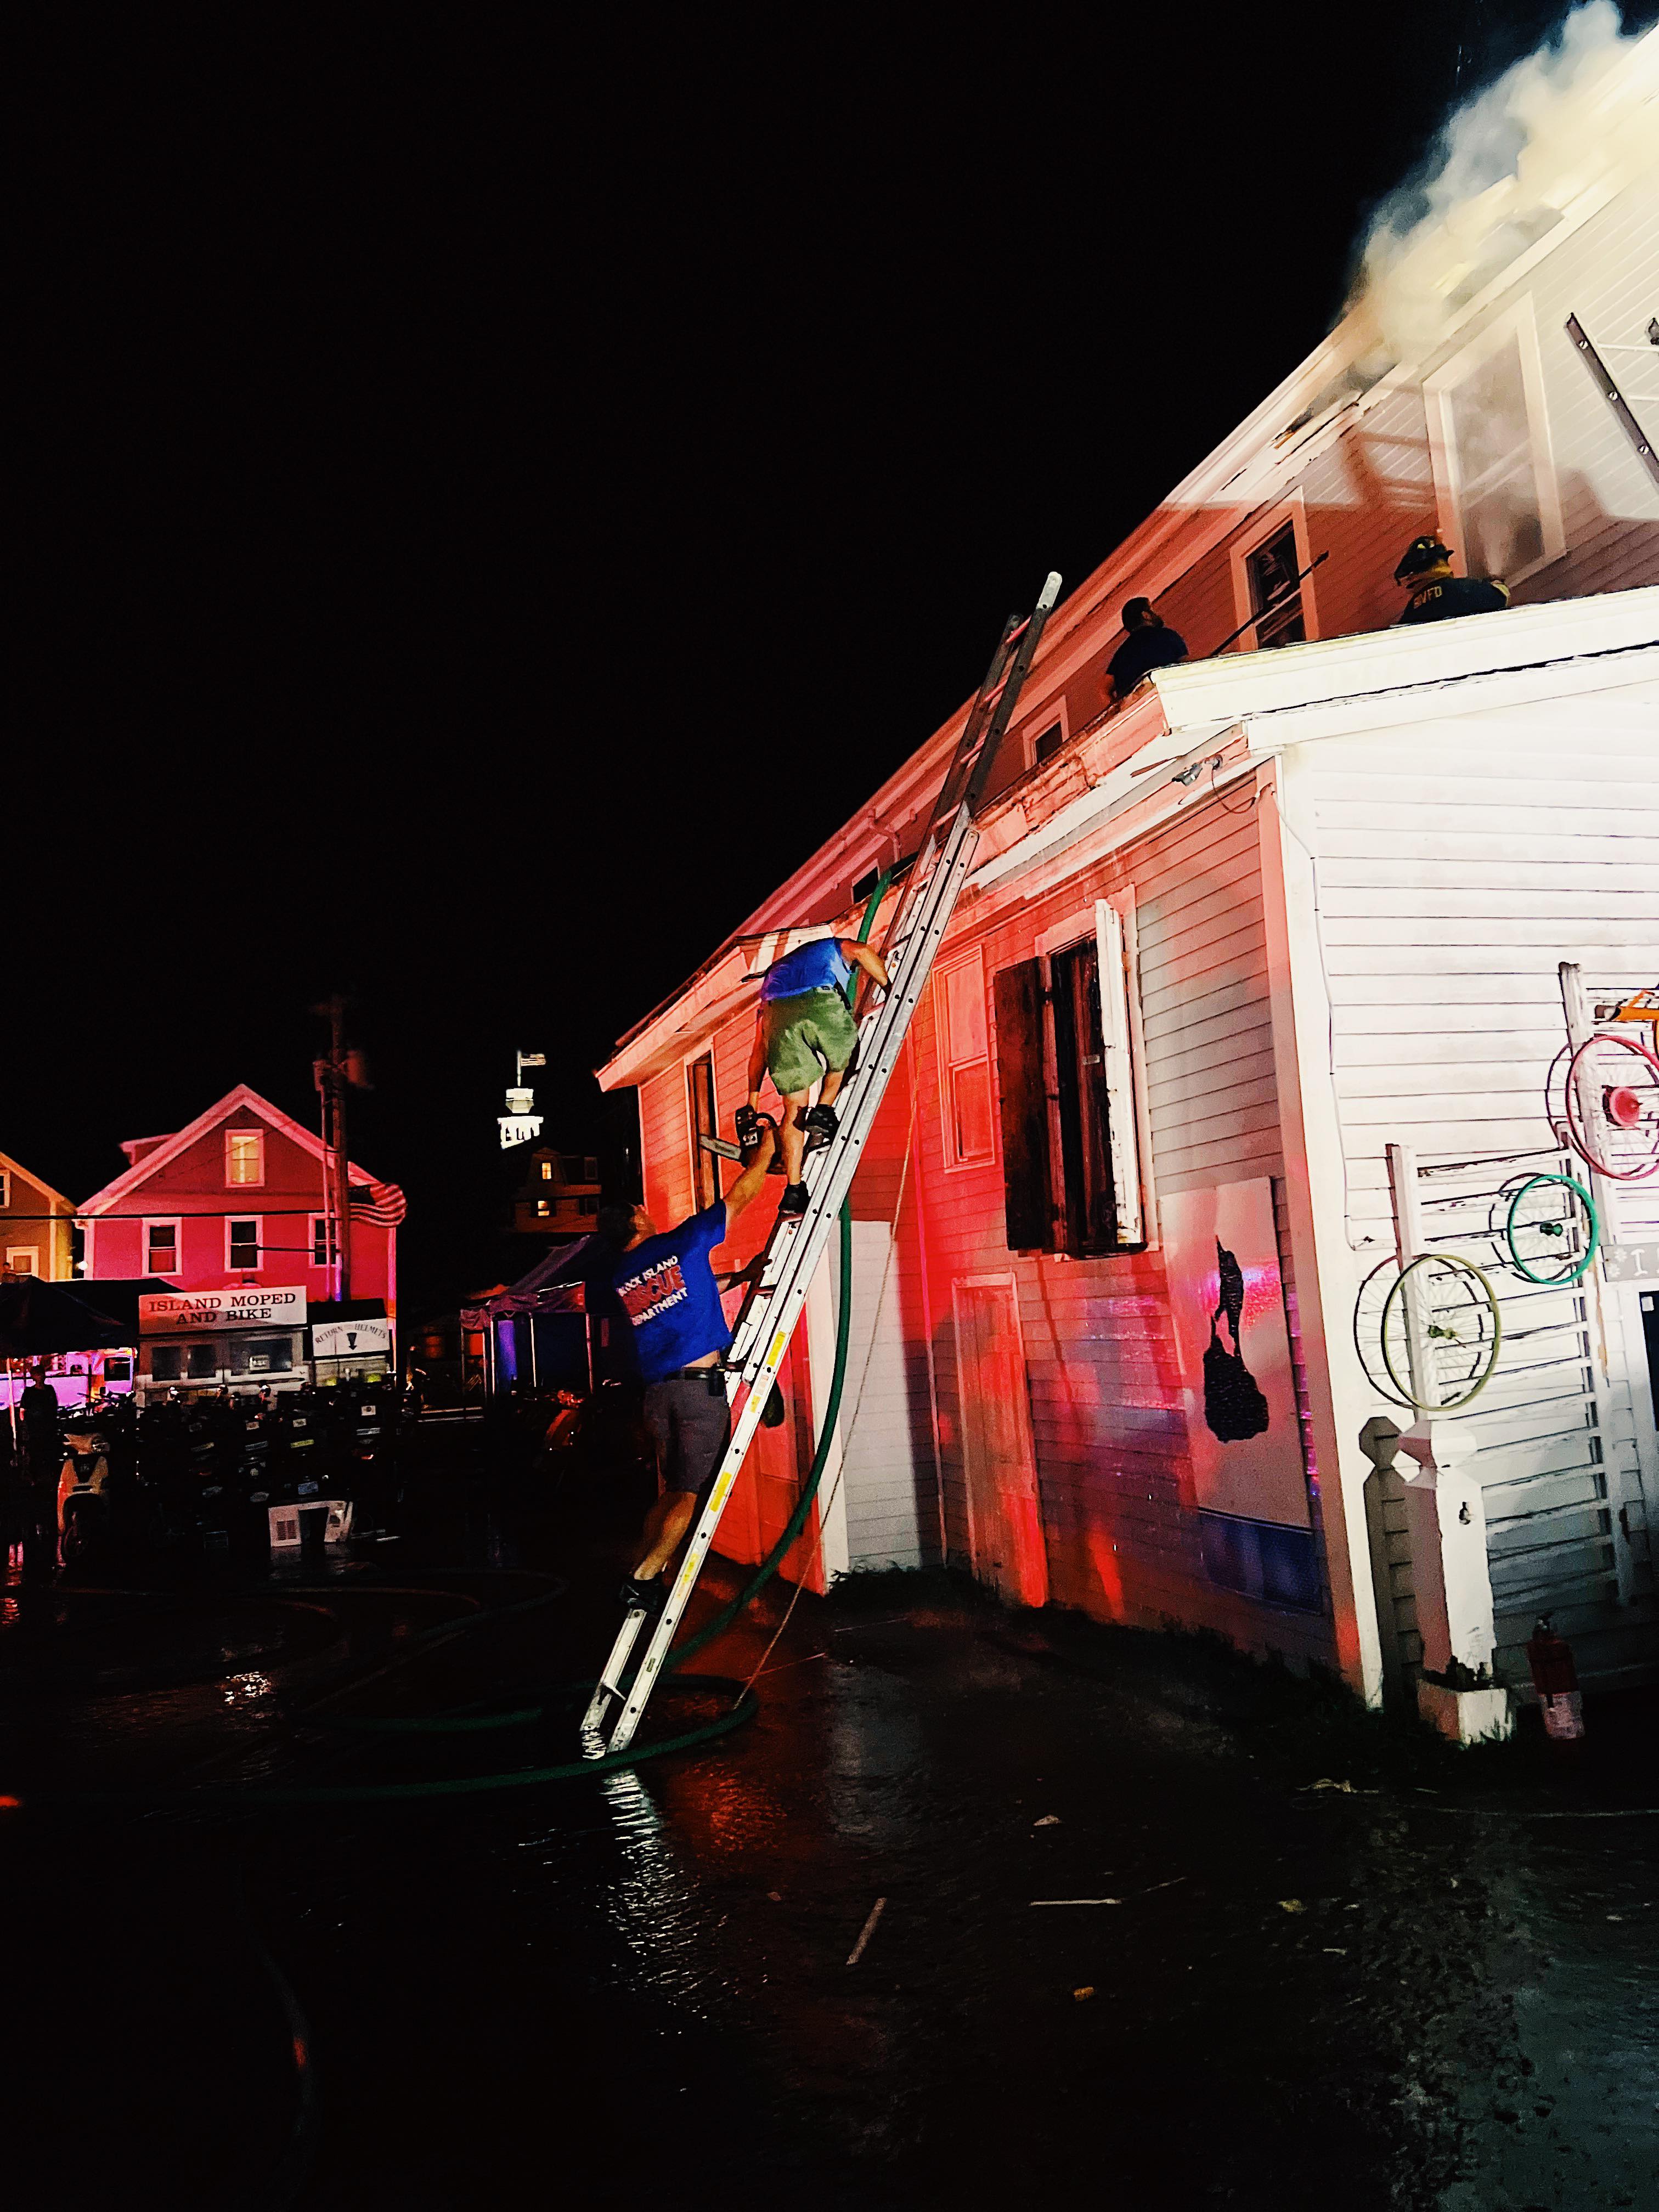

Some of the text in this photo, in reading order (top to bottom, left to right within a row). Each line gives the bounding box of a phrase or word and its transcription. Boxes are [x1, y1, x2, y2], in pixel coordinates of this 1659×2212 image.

[148, 1293, 296, 1312] ISLAND MOPED
[176, 1308, 272, 1325] AND BIKE
[314, 1323, 387, 1344] RETURN HELMETS
